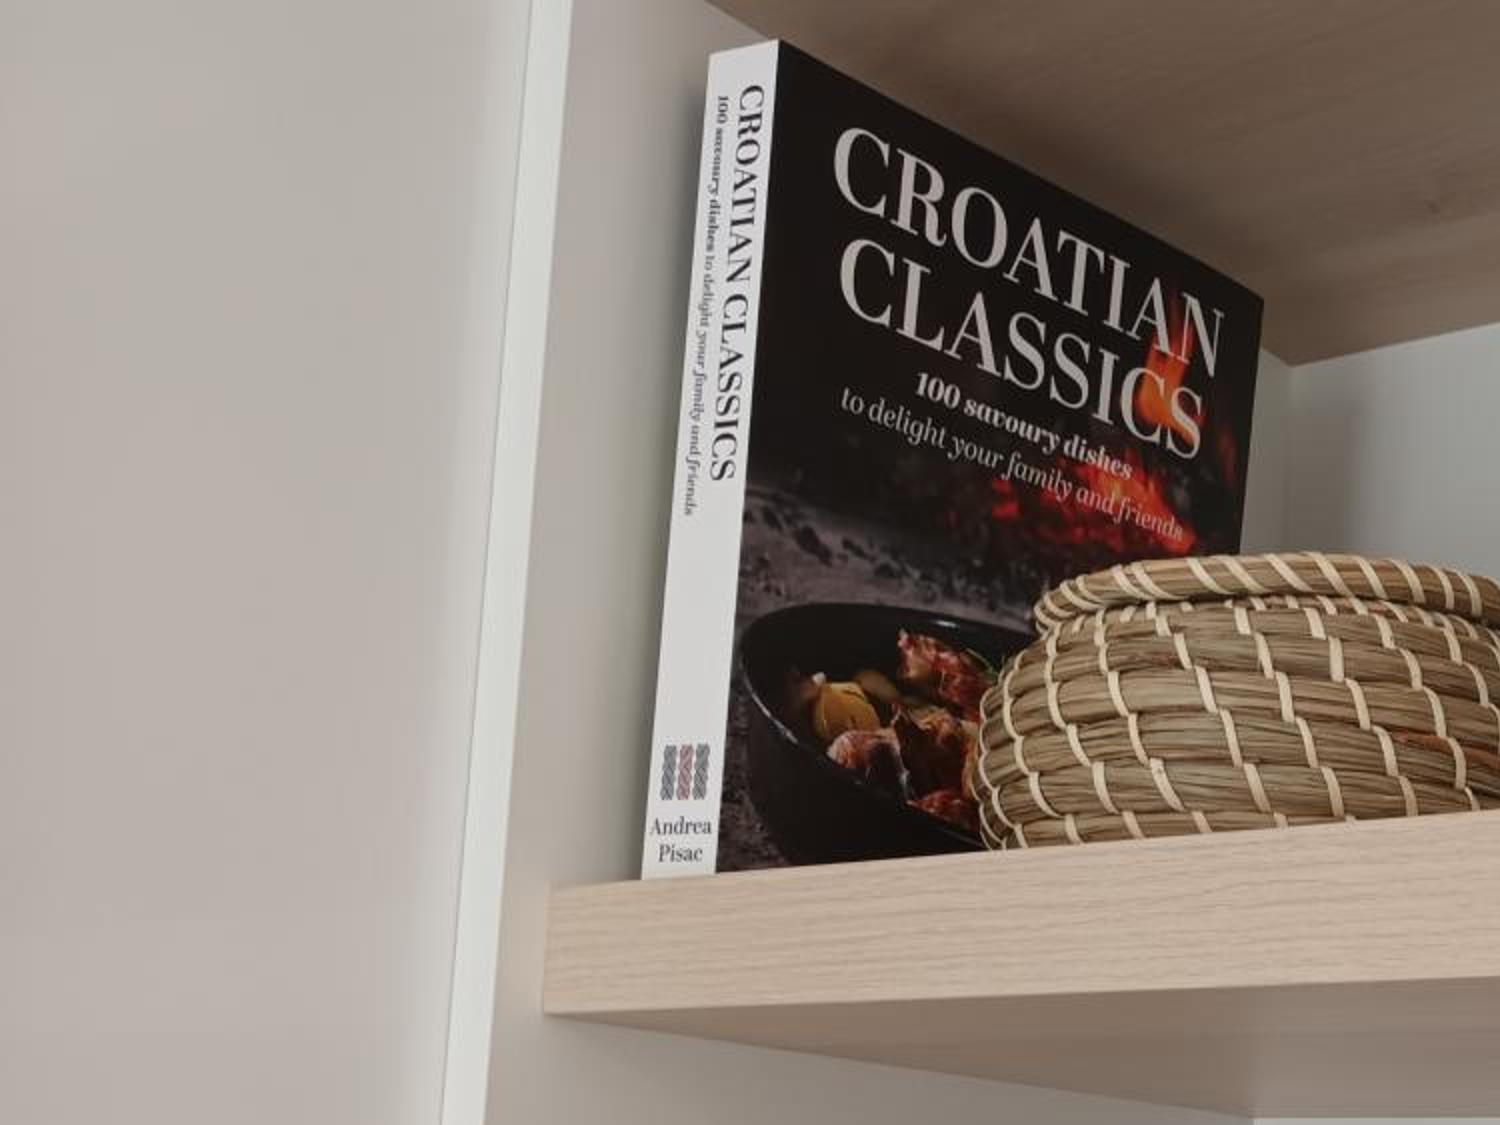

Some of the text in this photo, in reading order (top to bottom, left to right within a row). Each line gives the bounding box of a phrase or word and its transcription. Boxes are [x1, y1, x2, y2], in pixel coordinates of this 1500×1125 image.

[685, 95, 729, 516] 100 savoury dishes to delight your family and friends
[710, 85, 765, 481] CROATIAN CLASSICS
[834, 127, 1225, 378] CROATIAN
[840, 238, 1203, 459] CLASSICS
[915, 372, 1133, 480] 100 savoury dishes
[841, 387, 1184, 542] to delight your family and friends
[650, 816, 712, 835] Andrea
[659, 843, 703, 862] Pisac
